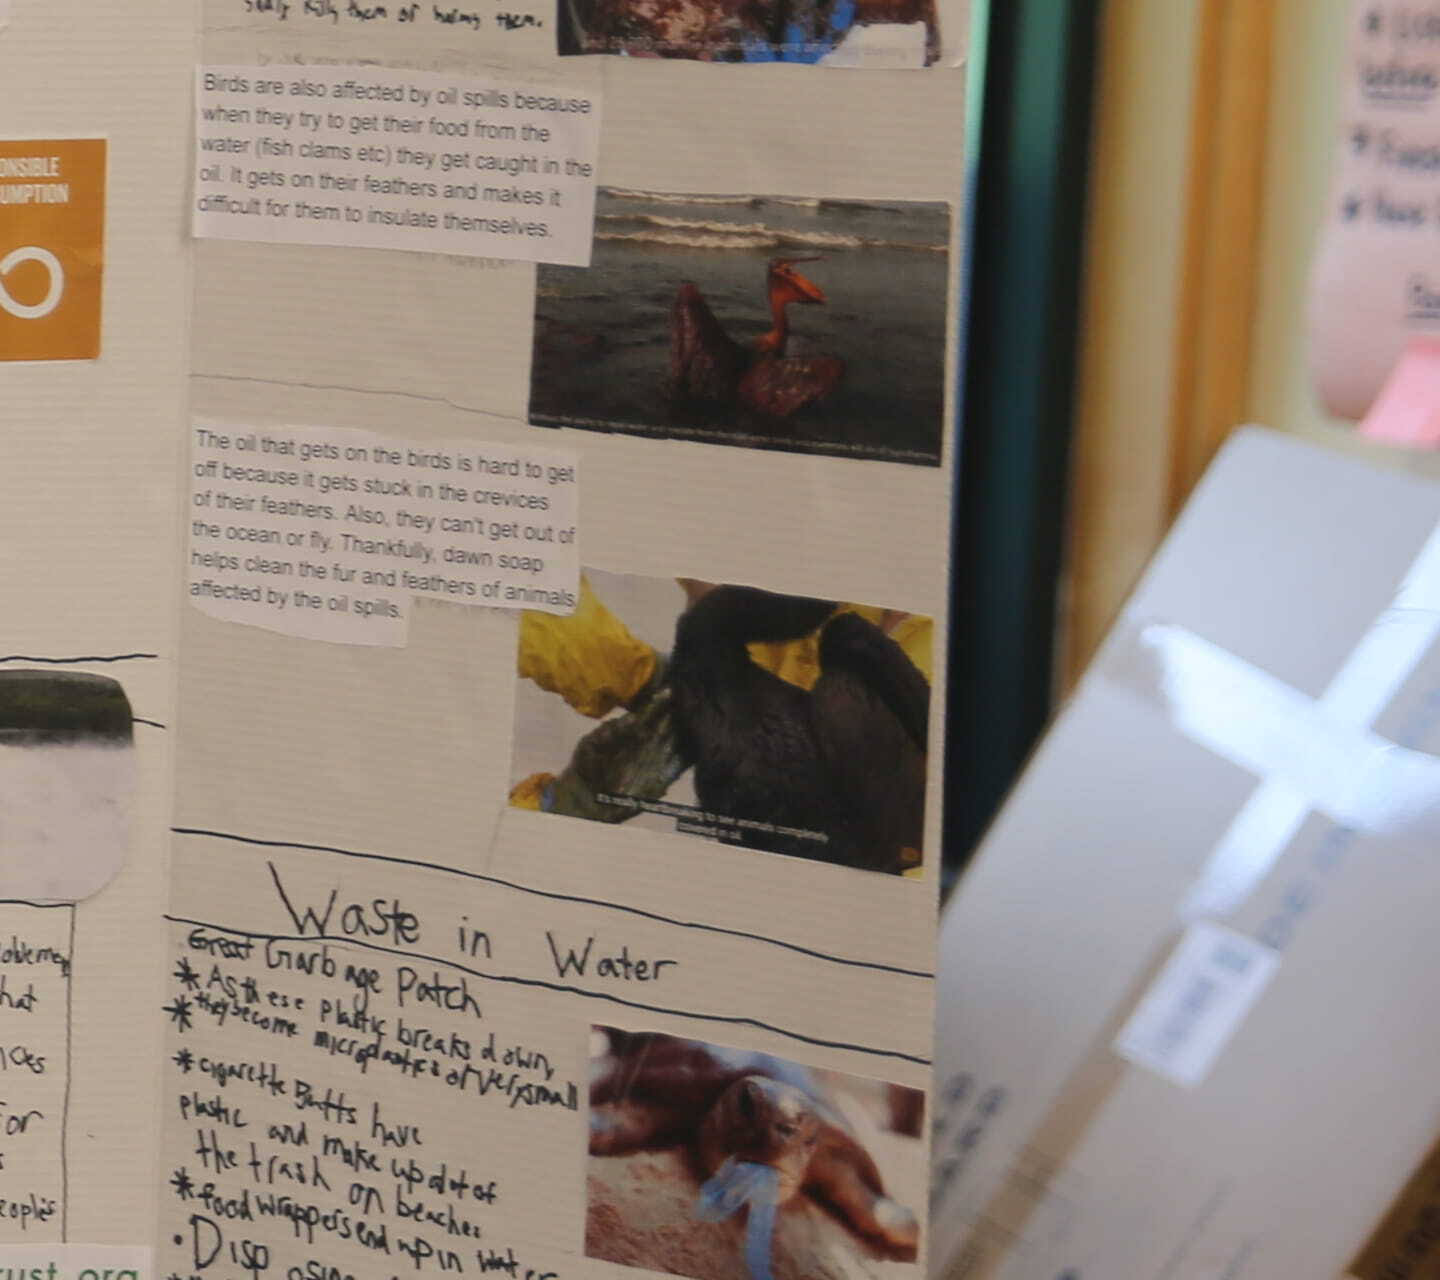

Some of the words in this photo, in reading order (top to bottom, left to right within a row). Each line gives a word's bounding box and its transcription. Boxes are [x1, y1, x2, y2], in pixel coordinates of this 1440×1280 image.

[204, 72, 249, 93] Birds
[255, 80, 284, 95] are
[289, 79, 327, 98] also
[332, 81, 404, 102] affected
[409, 87, 431, 108] by
[436, 87, 457, 105] oil
[463, 90, 510, 109] spills
[514, 91, 592, 115] because
[196, 429, 231, 450] The
[236, 435, 255, 451] oil
[260, 438, 296, 456] that
[299, 443, 340, 462] gets
[344, 447, 368, 461] on
[373, 448, 402, 466] the
[407, 449, 452, 471] birds
[457, 457, 473, 472] is
[478, 456, 520, 477] hard
[524, 461, 543, 479] to
[547, 466, 575, 485] get
[268, 861, 420, 943] Waste
[458, 918, 492, 960] in
[546, 931, 680, 981] Water
